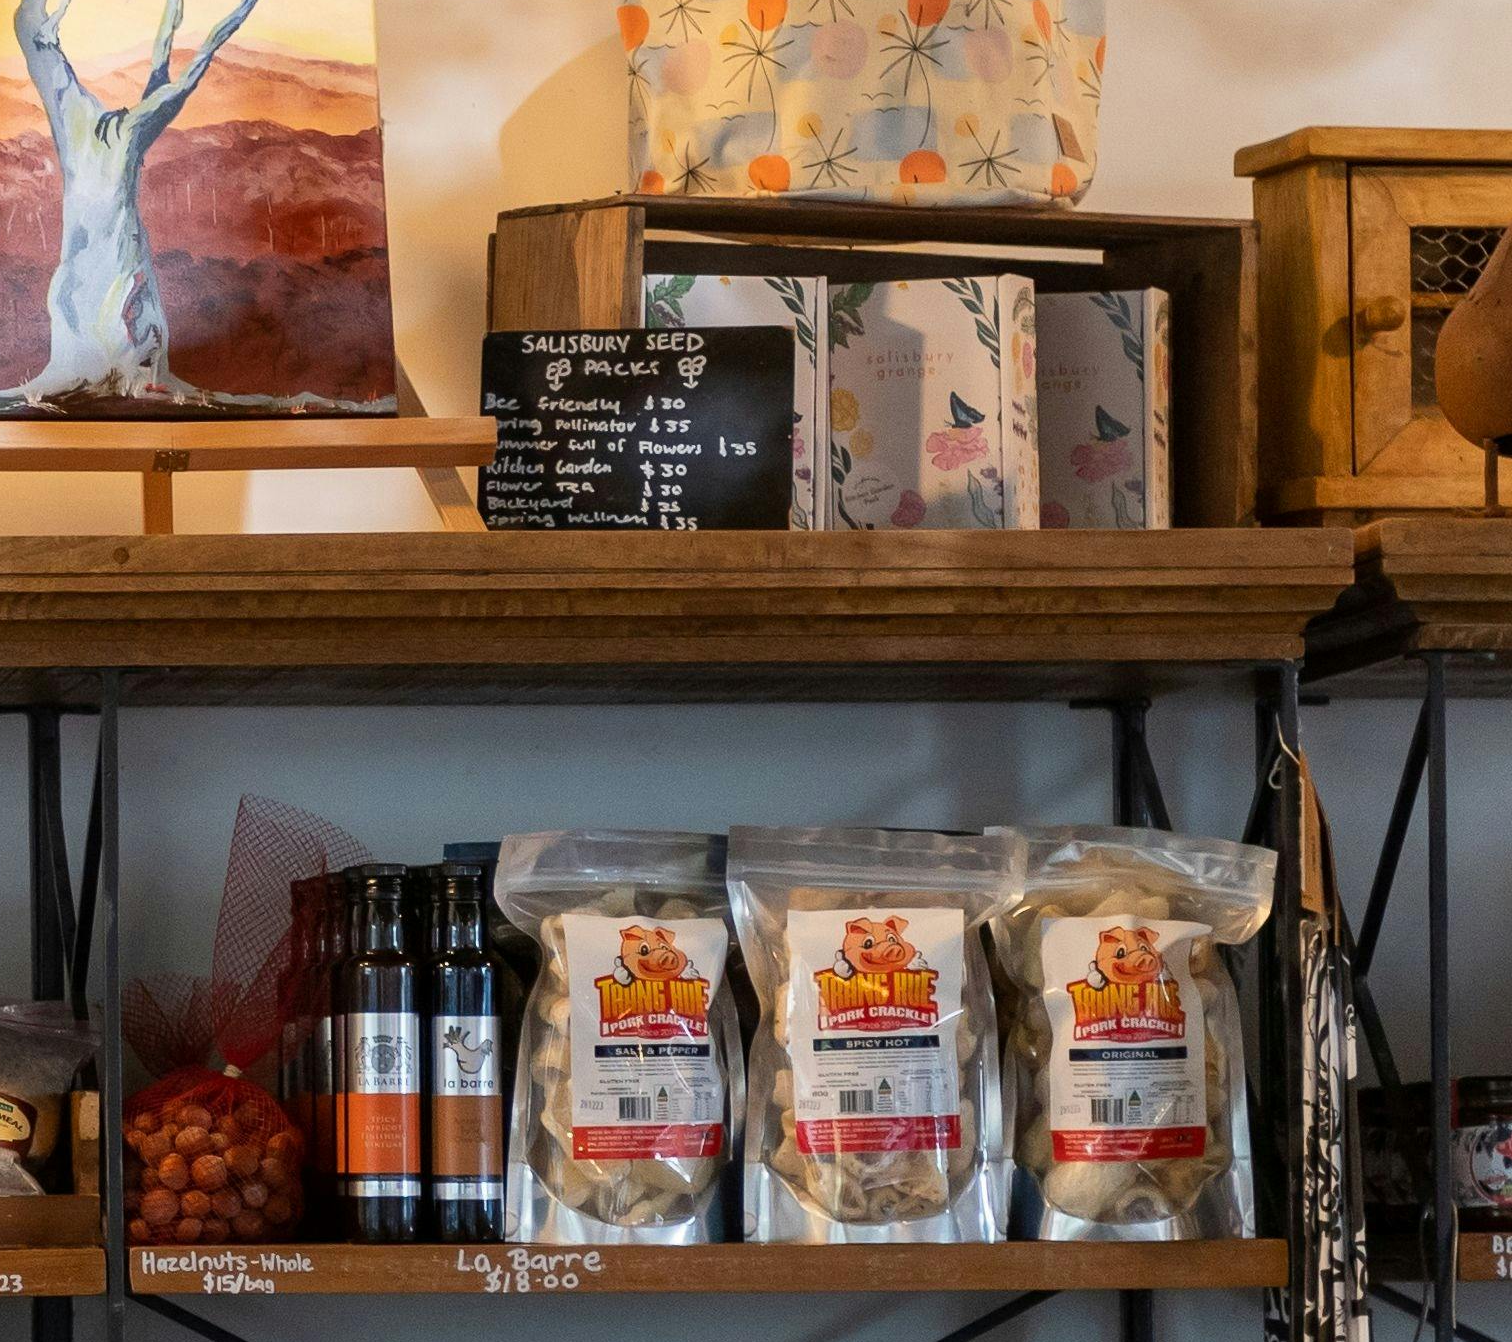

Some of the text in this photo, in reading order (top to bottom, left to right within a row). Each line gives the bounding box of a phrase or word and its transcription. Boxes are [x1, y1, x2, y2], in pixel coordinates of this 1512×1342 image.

[522, 334, 704, 354] SALISBURY SEED
[485, 393, 520, 409] Bee
[556, 420, 636, 432] Pollinator
[639, 441, 702, 454] Flowers
[486, 457, 612, 474] Kitchen Garden
[487, 481, 542, 492] Flower
[487, 497, 573, 510] Backyard
[884, 1038, 910, 1048] HOT
[1102, 1051, 1158, 1059] ORIGINAL
[512, 1249, 601, 1274] Barre
[203, 1275, 275, 1294] $15/bag
